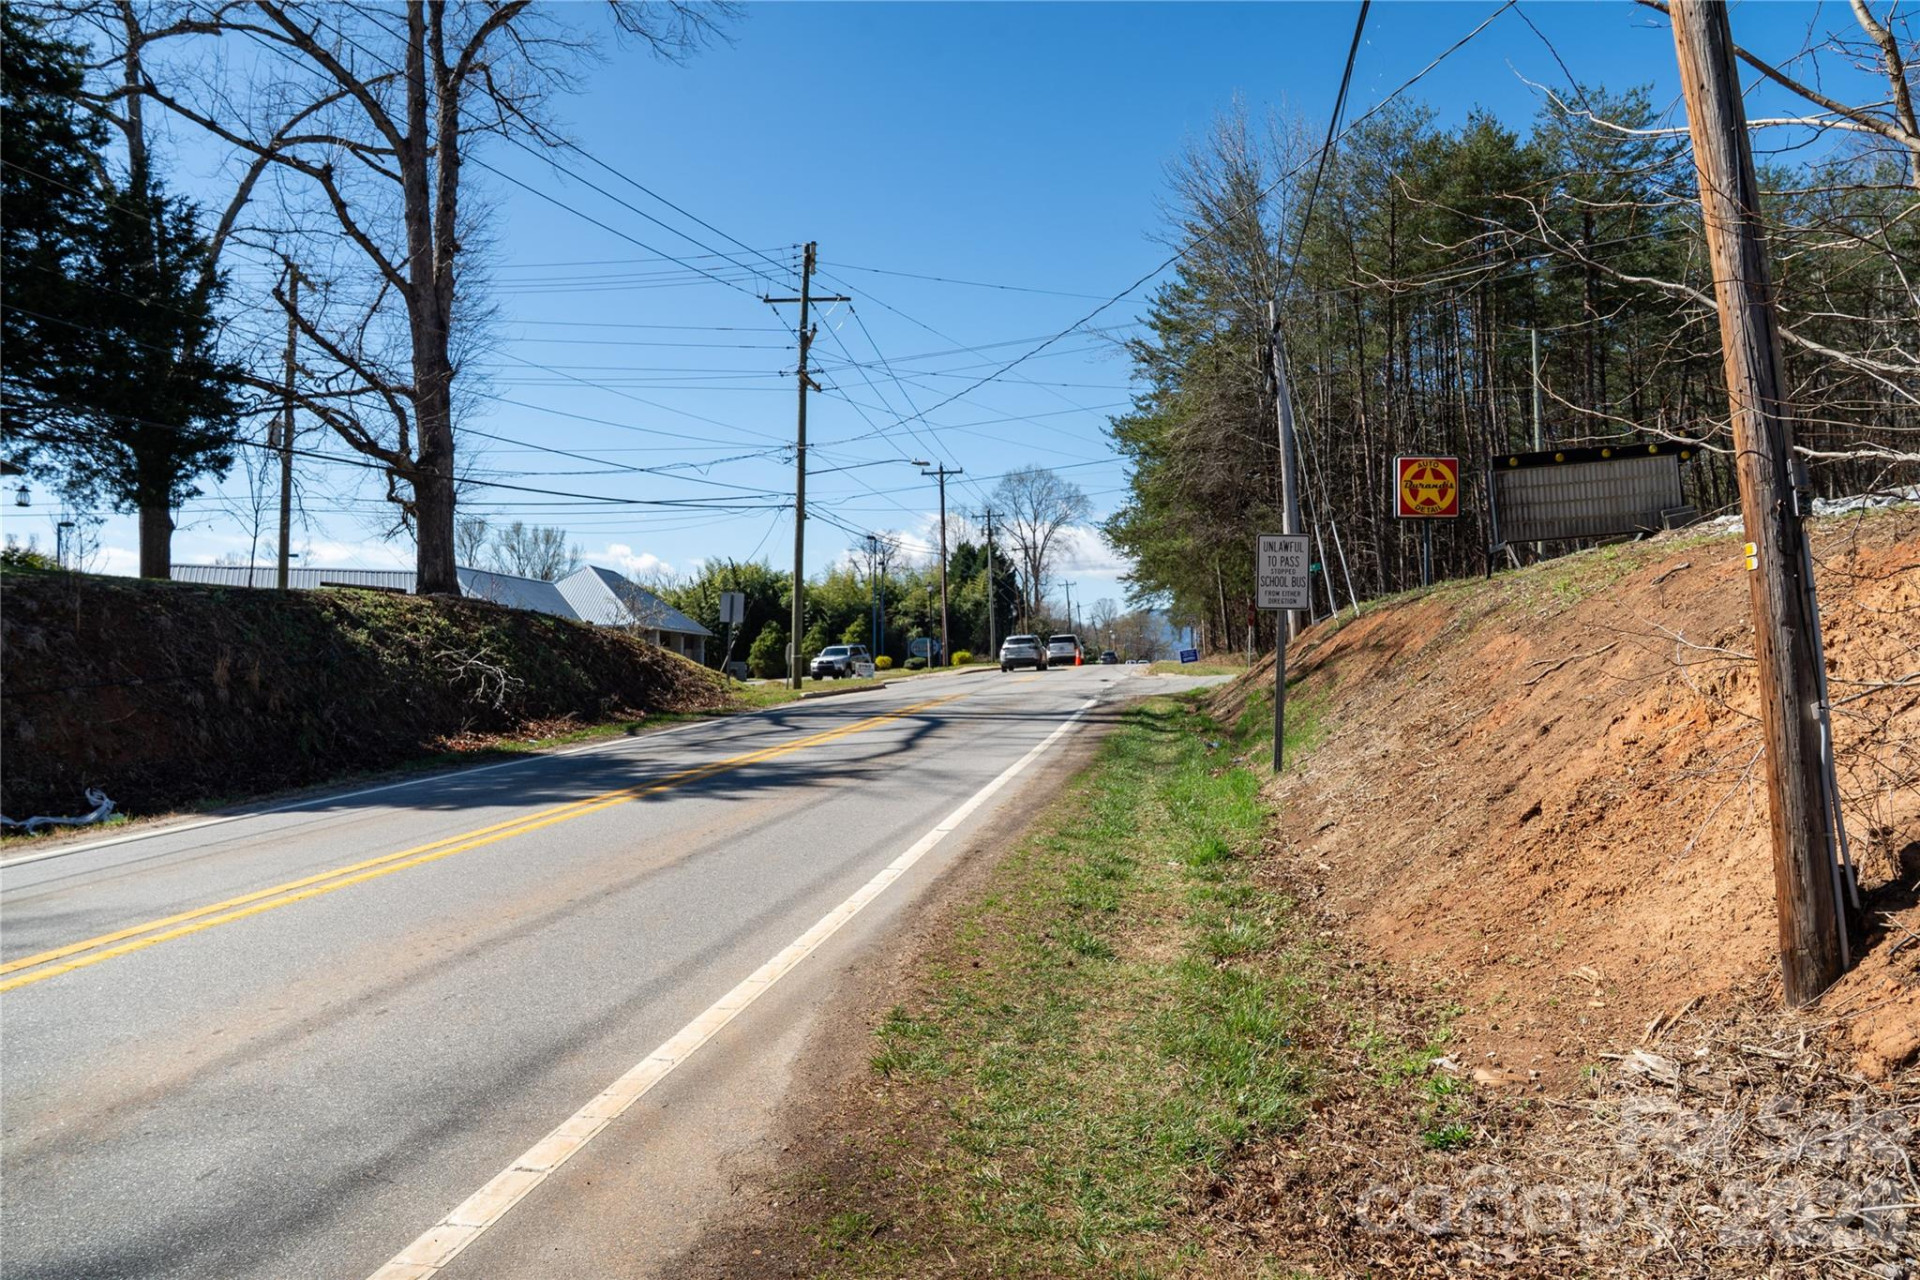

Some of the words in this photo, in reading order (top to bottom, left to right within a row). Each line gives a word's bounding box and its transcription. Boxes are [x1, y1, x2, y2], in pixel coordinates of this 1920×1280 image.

[1415, 505, 1442, 513] DETAIL
[1263, 542, 1304, 552] UNLAWFUL
[1268, 556, 1277, 567] TO
[1280, 556, 1300, 567] PASS
[1260, 576, 1289, 587] SCHOOL
[1291, 576, 1306, 587] BUS
